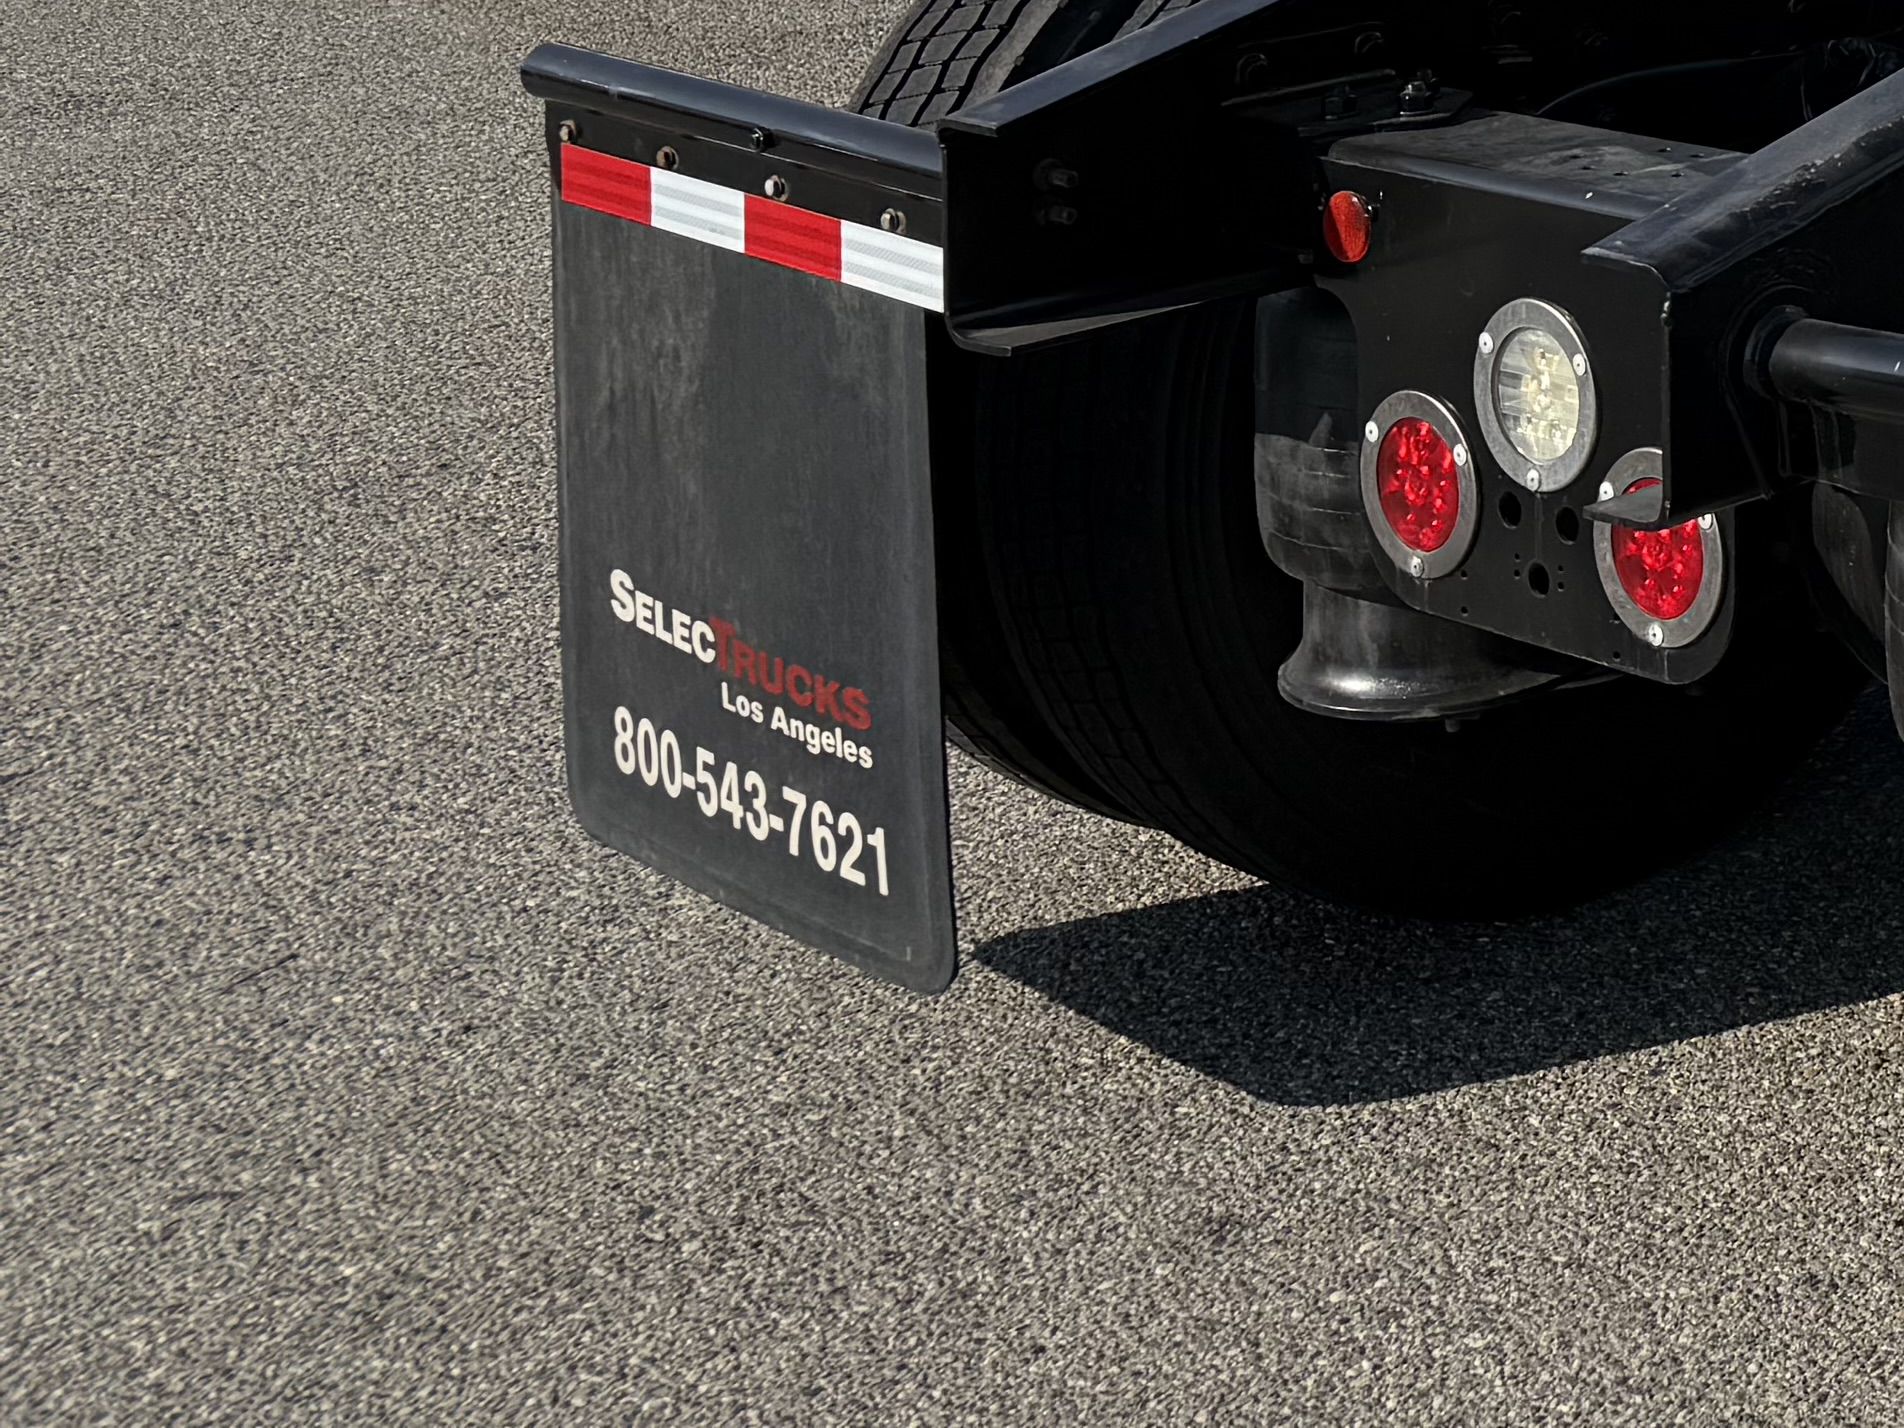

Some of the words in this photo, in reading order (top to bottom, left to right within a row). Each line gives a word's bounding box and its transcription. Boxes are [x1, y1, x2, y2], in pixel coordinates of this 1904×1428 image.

[721, 681, 764, 724] Los
[770, 706, 873, 769] Angeles
[613, 705, 889, 897] 800-543-7621
